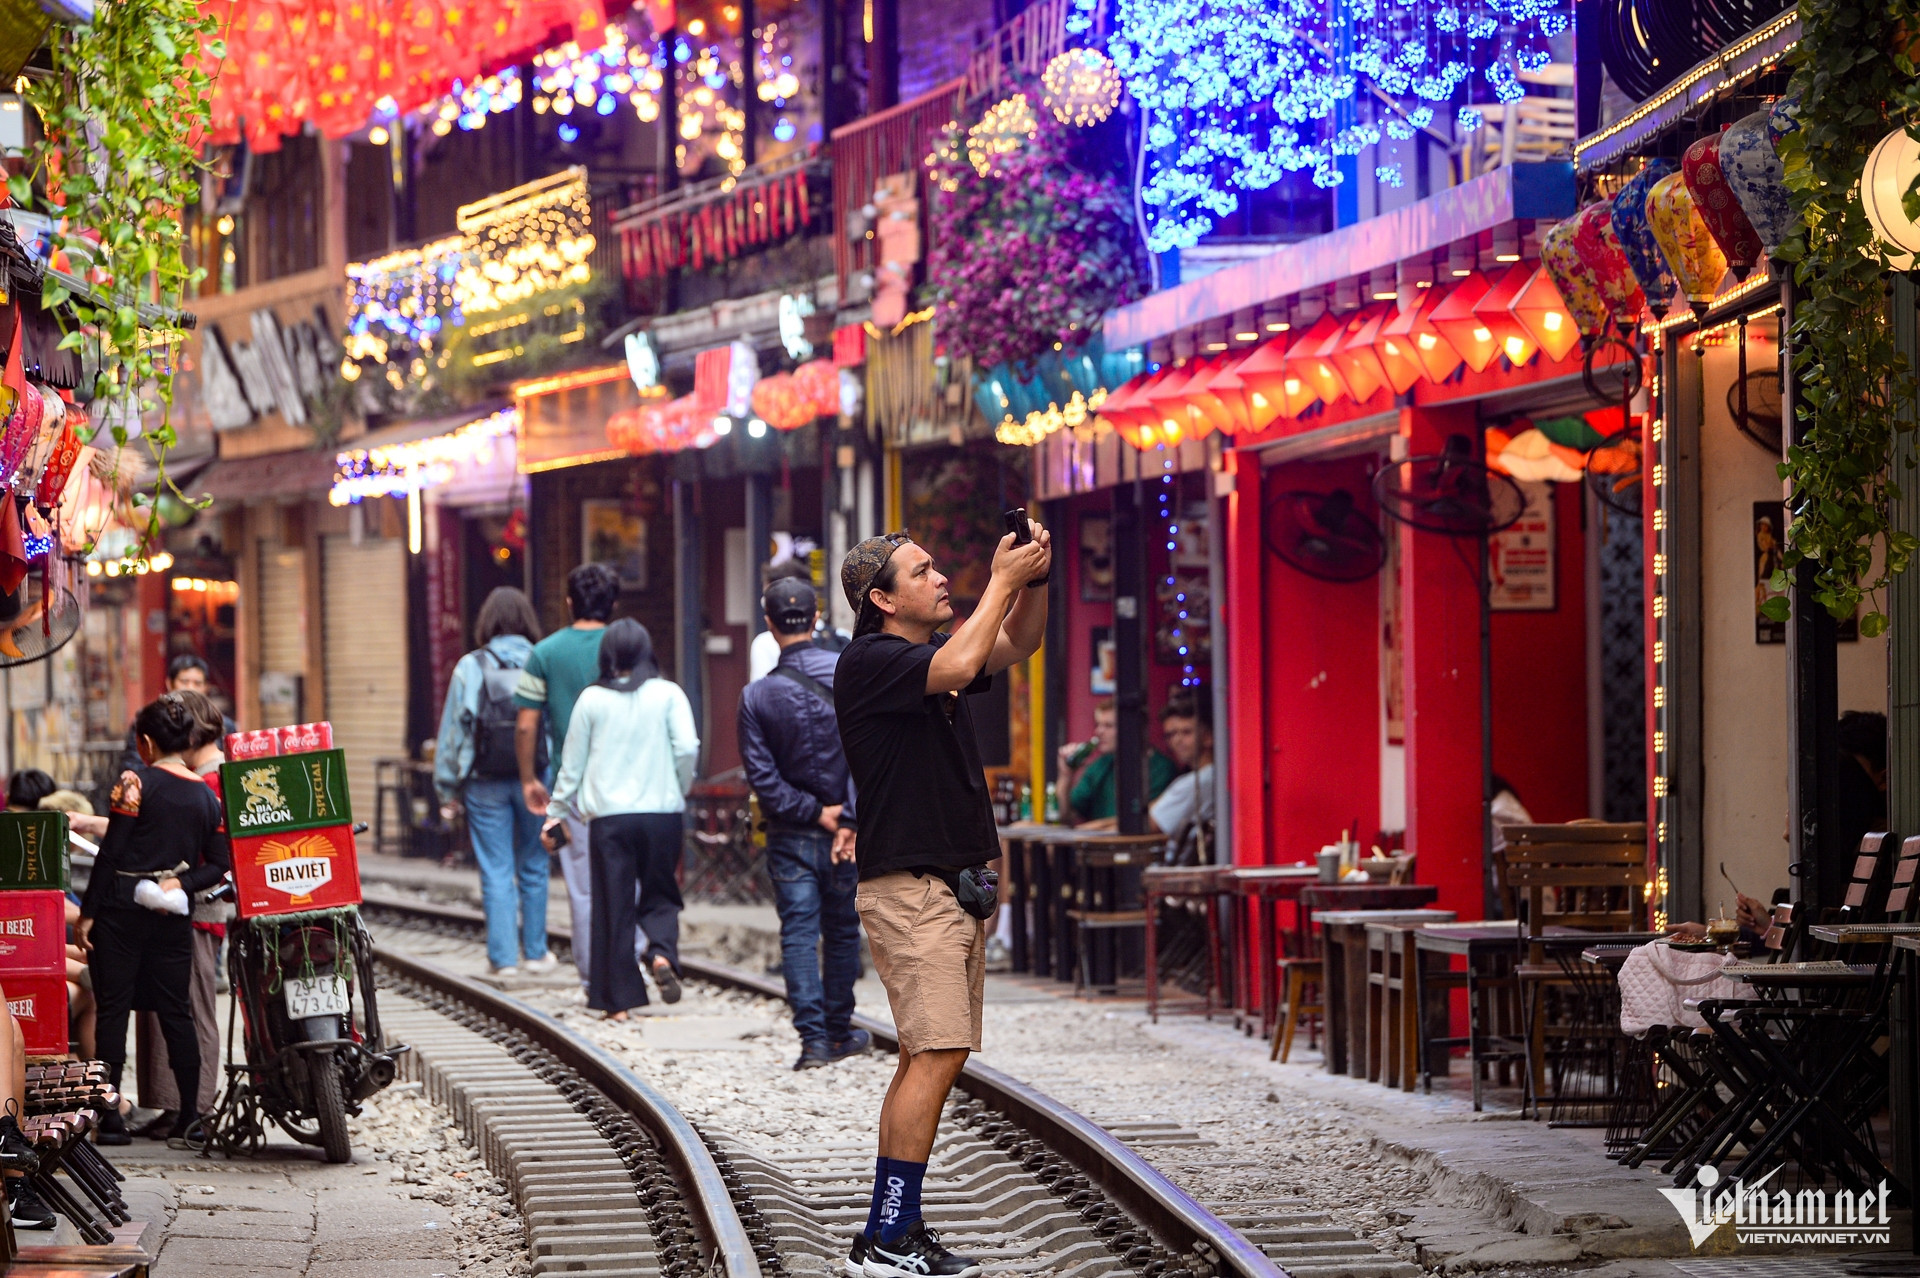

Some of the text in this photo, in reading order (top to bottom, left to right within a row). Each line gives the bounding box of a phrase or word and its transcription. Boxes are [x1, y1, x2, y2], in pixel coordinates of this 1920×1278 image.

[312, 760, 327, 817] SPECIAL
[239, 809, 291, 827] SAIGON
[255, 804, 273, 813] BIA
[26, 822, 37, 881] SPECIAL
[269, 860, 326, 883] BIA VIỆT
[6, 917, 35, 938] BEER
